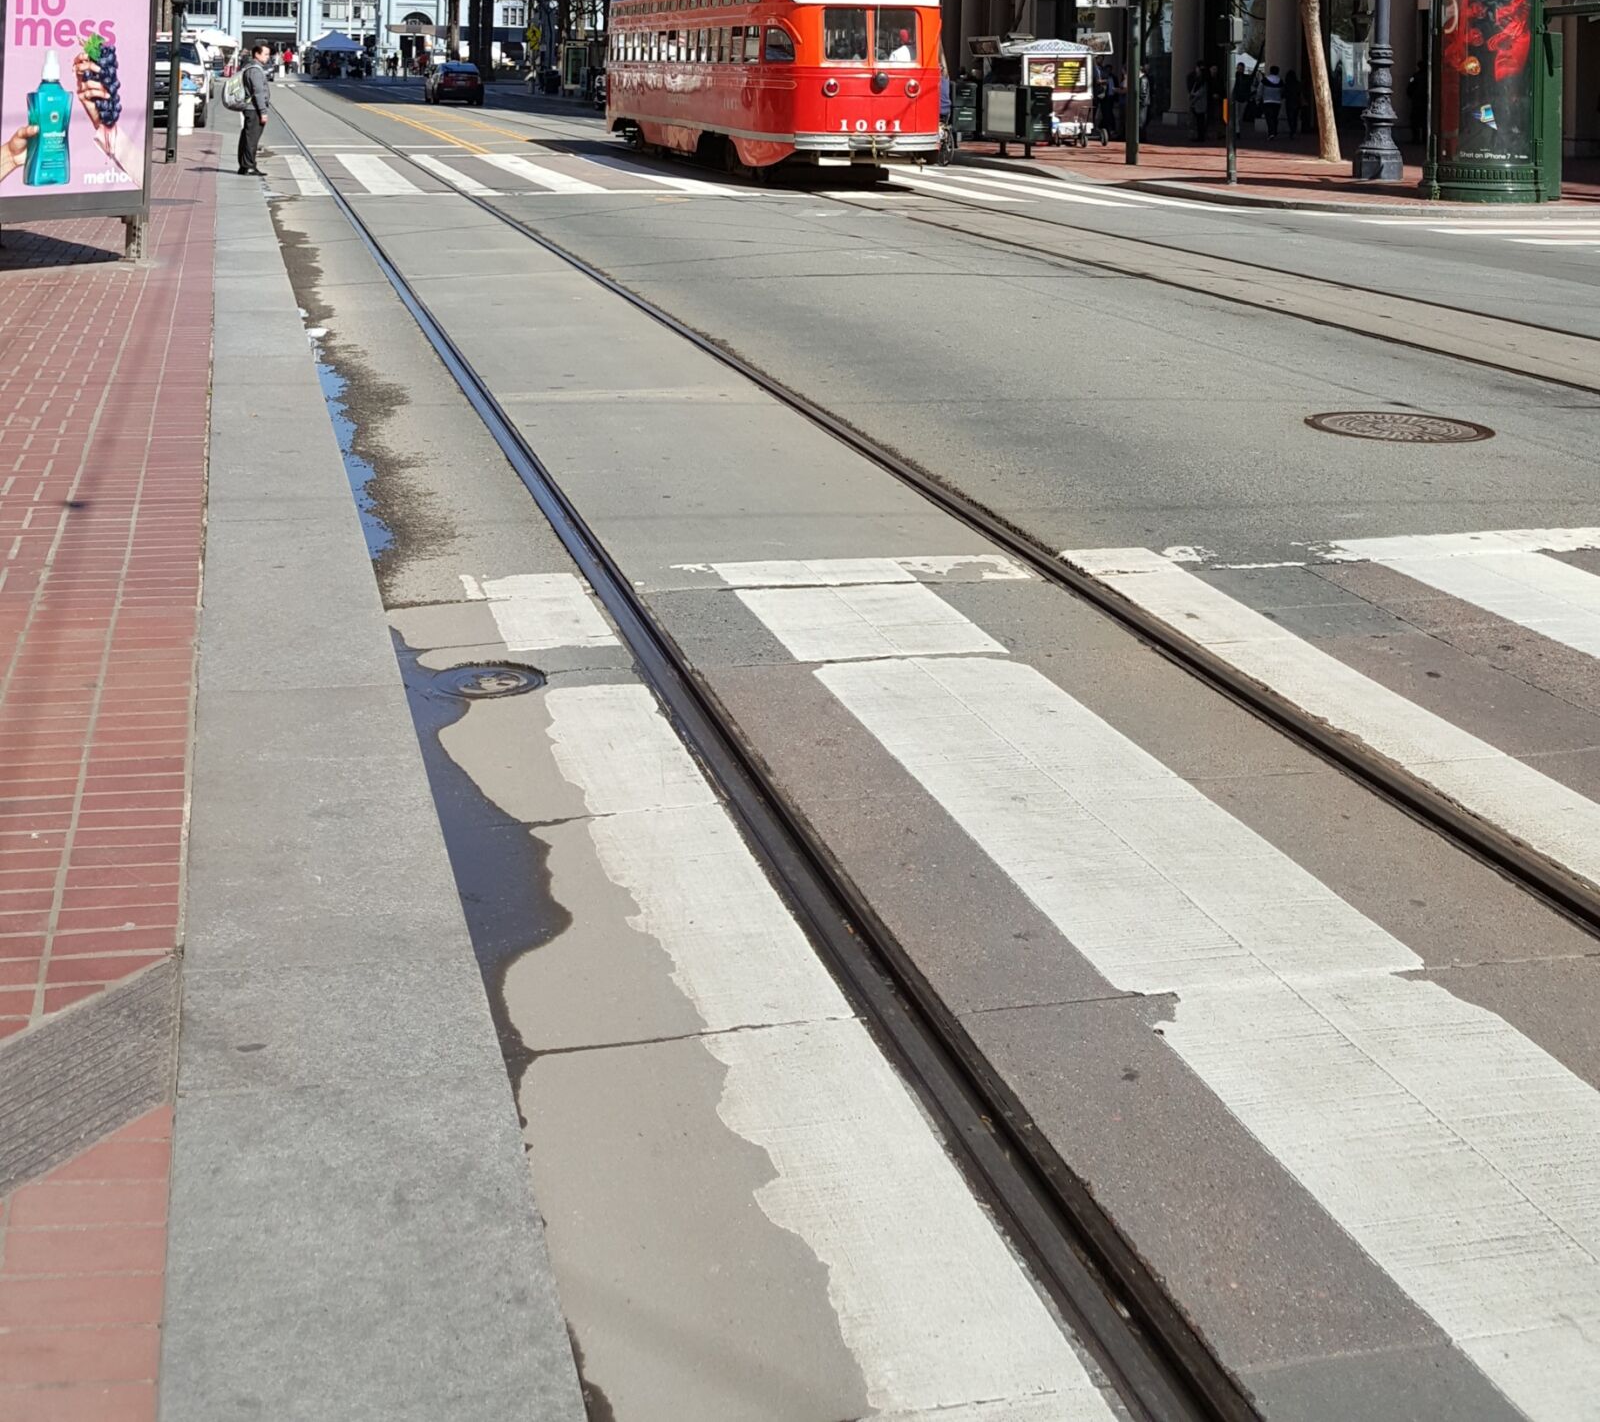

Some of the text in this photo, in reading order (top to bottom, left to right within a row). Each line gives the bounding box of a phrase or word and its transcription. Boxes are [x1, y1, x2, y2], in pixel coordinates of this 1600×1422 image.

[14, 18, 117, 48] mess
[840, 119, 901, 131] 1061
[83, 168, 133, 184] metho
